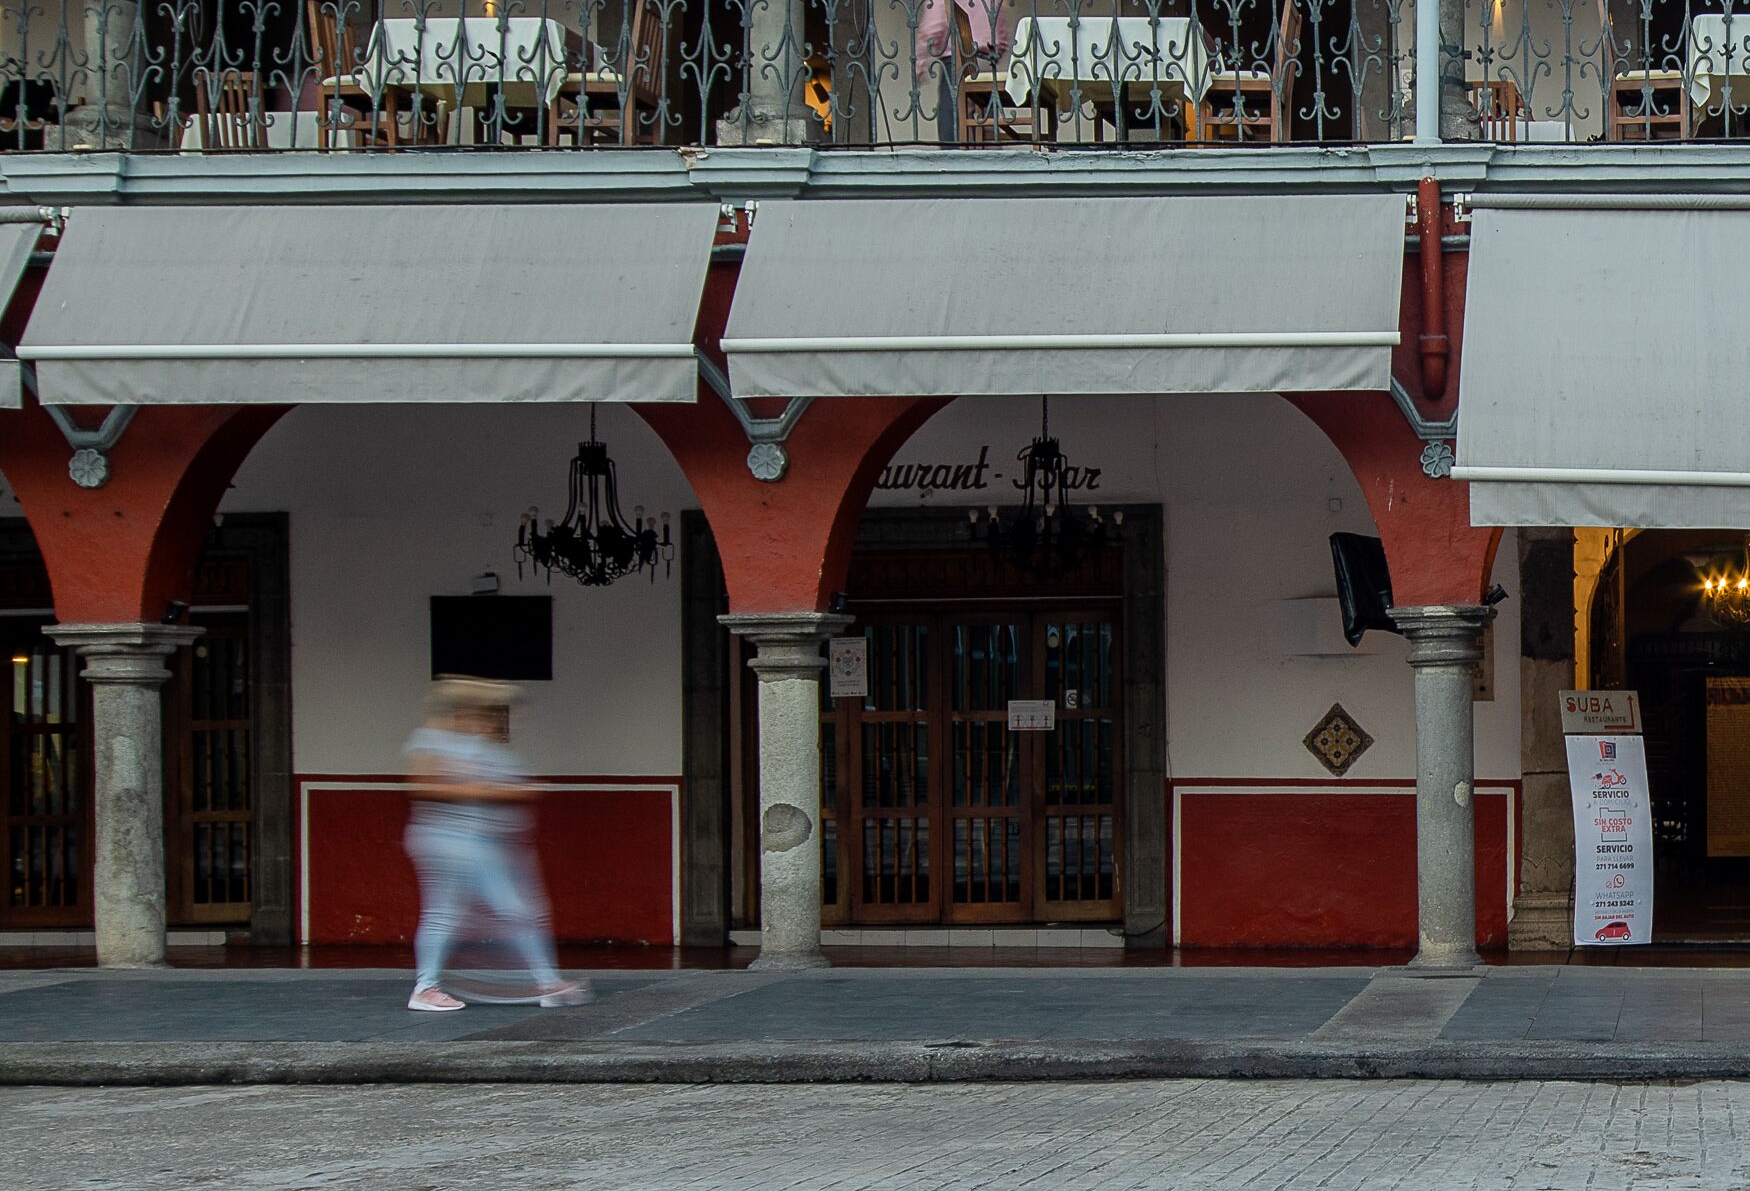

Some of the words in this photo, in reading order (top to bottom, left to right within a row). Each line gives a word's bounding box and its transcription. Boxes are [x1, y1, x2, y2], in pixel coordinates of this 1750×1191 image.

[876, 446, 990, 490] aurant
[1566, 696, 1614, 713] SUBA
[1583, 715, 1627, 724] RESTAURANTE
[1592, 790, 1630, 799] SERVICIO
[1594, 818, 1606, 826] SIN
[1608, 818, 1632, 826] COSTO
[1601, 825, 1626, 833] EXTRA
[1596, 844, 1633, 854] SERVICIO
[1595, 891, 1634, 900] WHATSAPP
